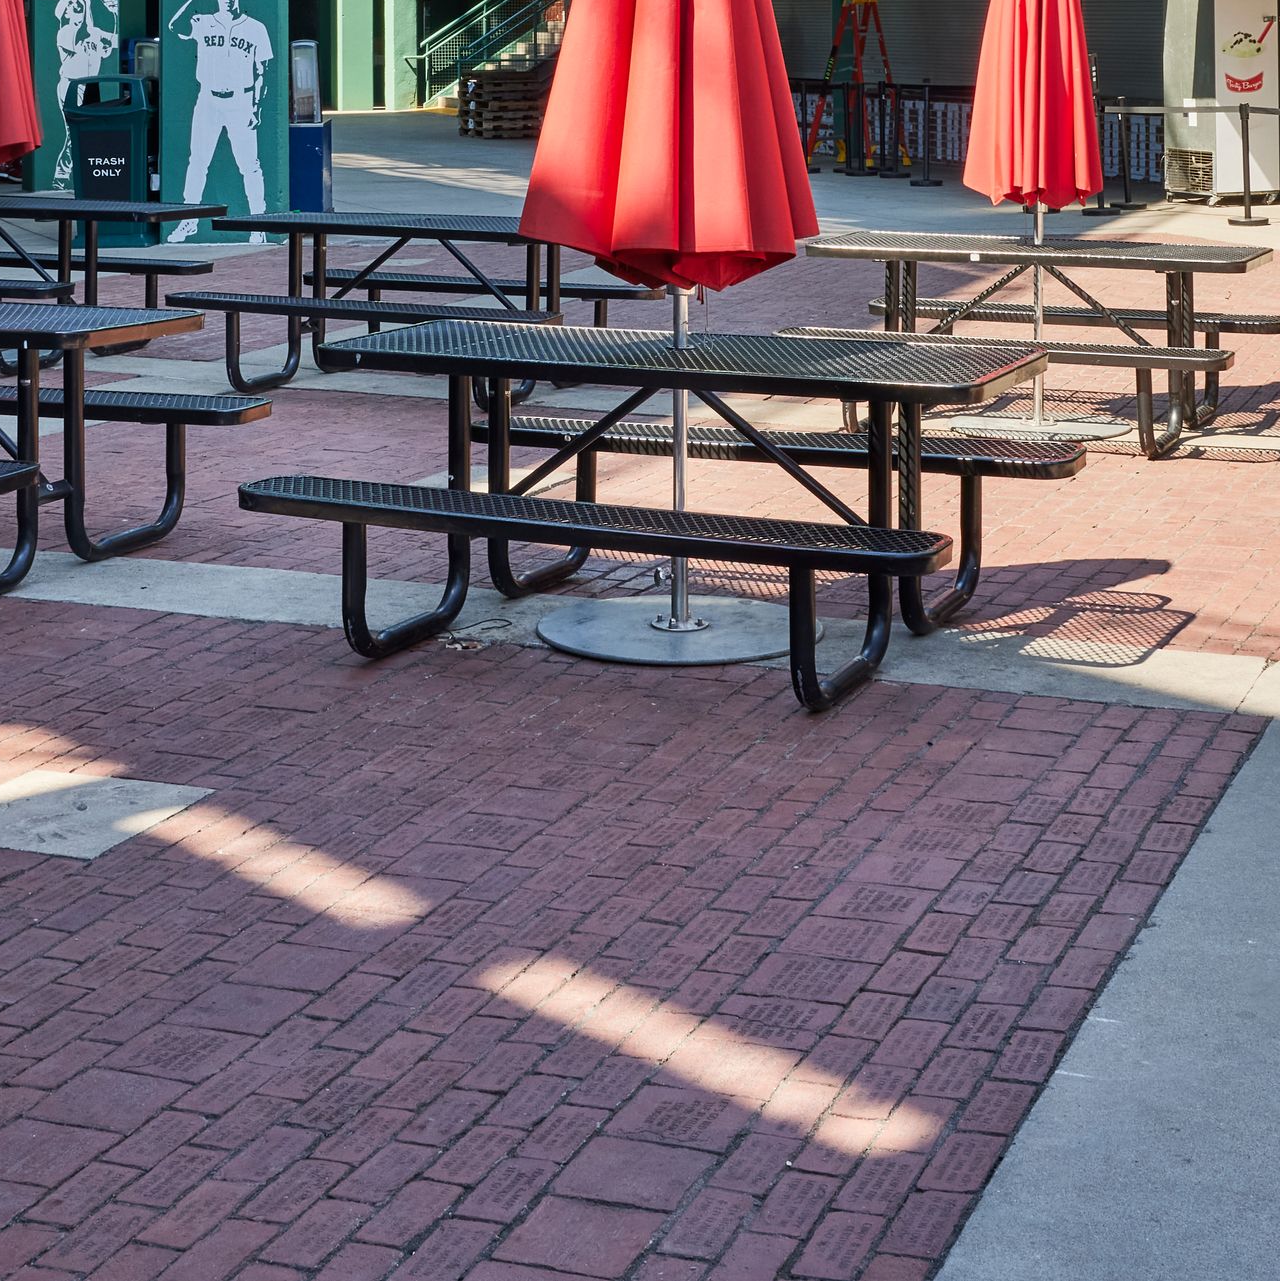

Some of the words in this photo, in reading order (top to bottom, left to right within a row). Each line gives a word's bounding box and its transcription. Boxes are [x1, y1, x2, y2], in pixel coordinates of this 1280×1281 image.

[204, 35, 225, 47] RED
[230, 37, 254, 54] SOX
[1227, 79, 1242, 91] Tasty
[1242, 81, 1262, 90] Burger
[88, 157, 125, 166] TRASH
[92, 169, 122, 177] ONLY
